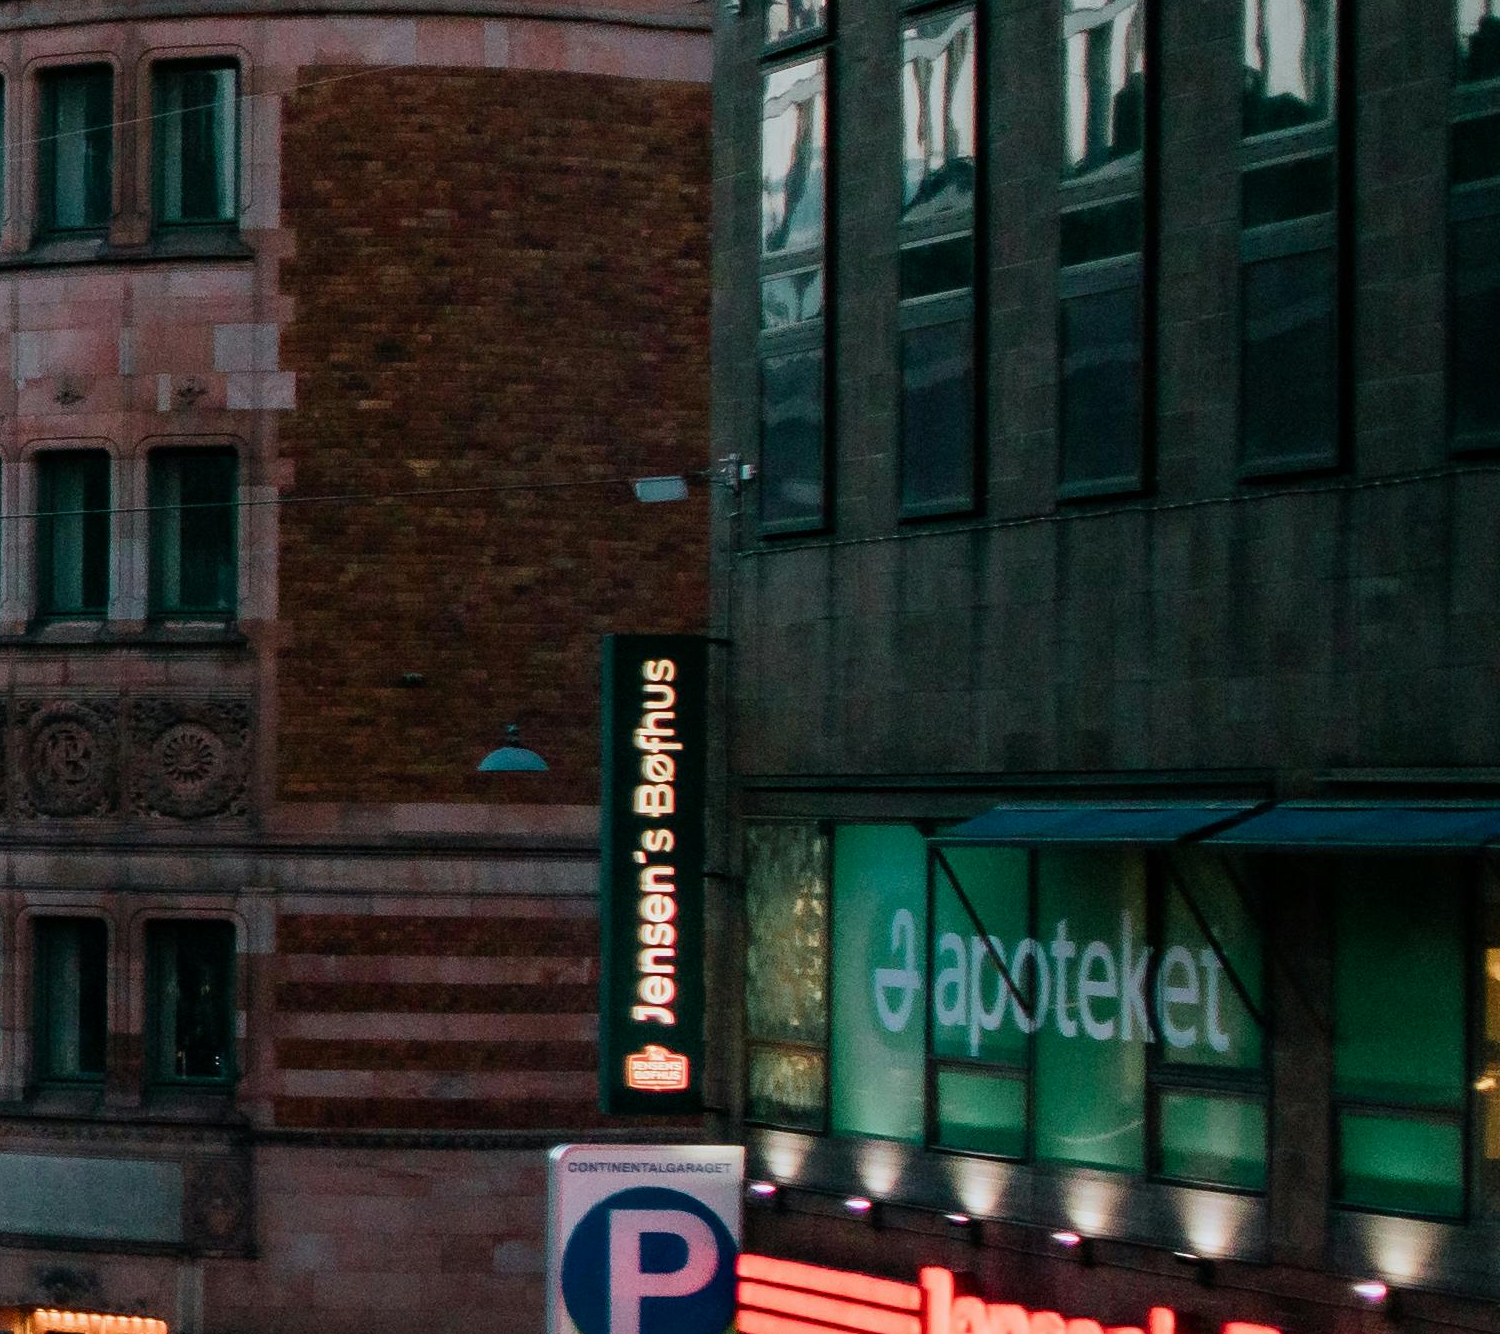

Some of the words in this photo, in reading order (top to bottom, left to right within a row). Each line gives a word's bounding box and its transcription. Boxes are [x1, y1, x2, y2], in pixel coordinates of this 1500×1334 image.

[633, 658, 683, 818] Bøfhus
[934, 907, 1230, 1058] apoteket
[567, 1161, 734, 1174] CONTINENTALGARAGET
